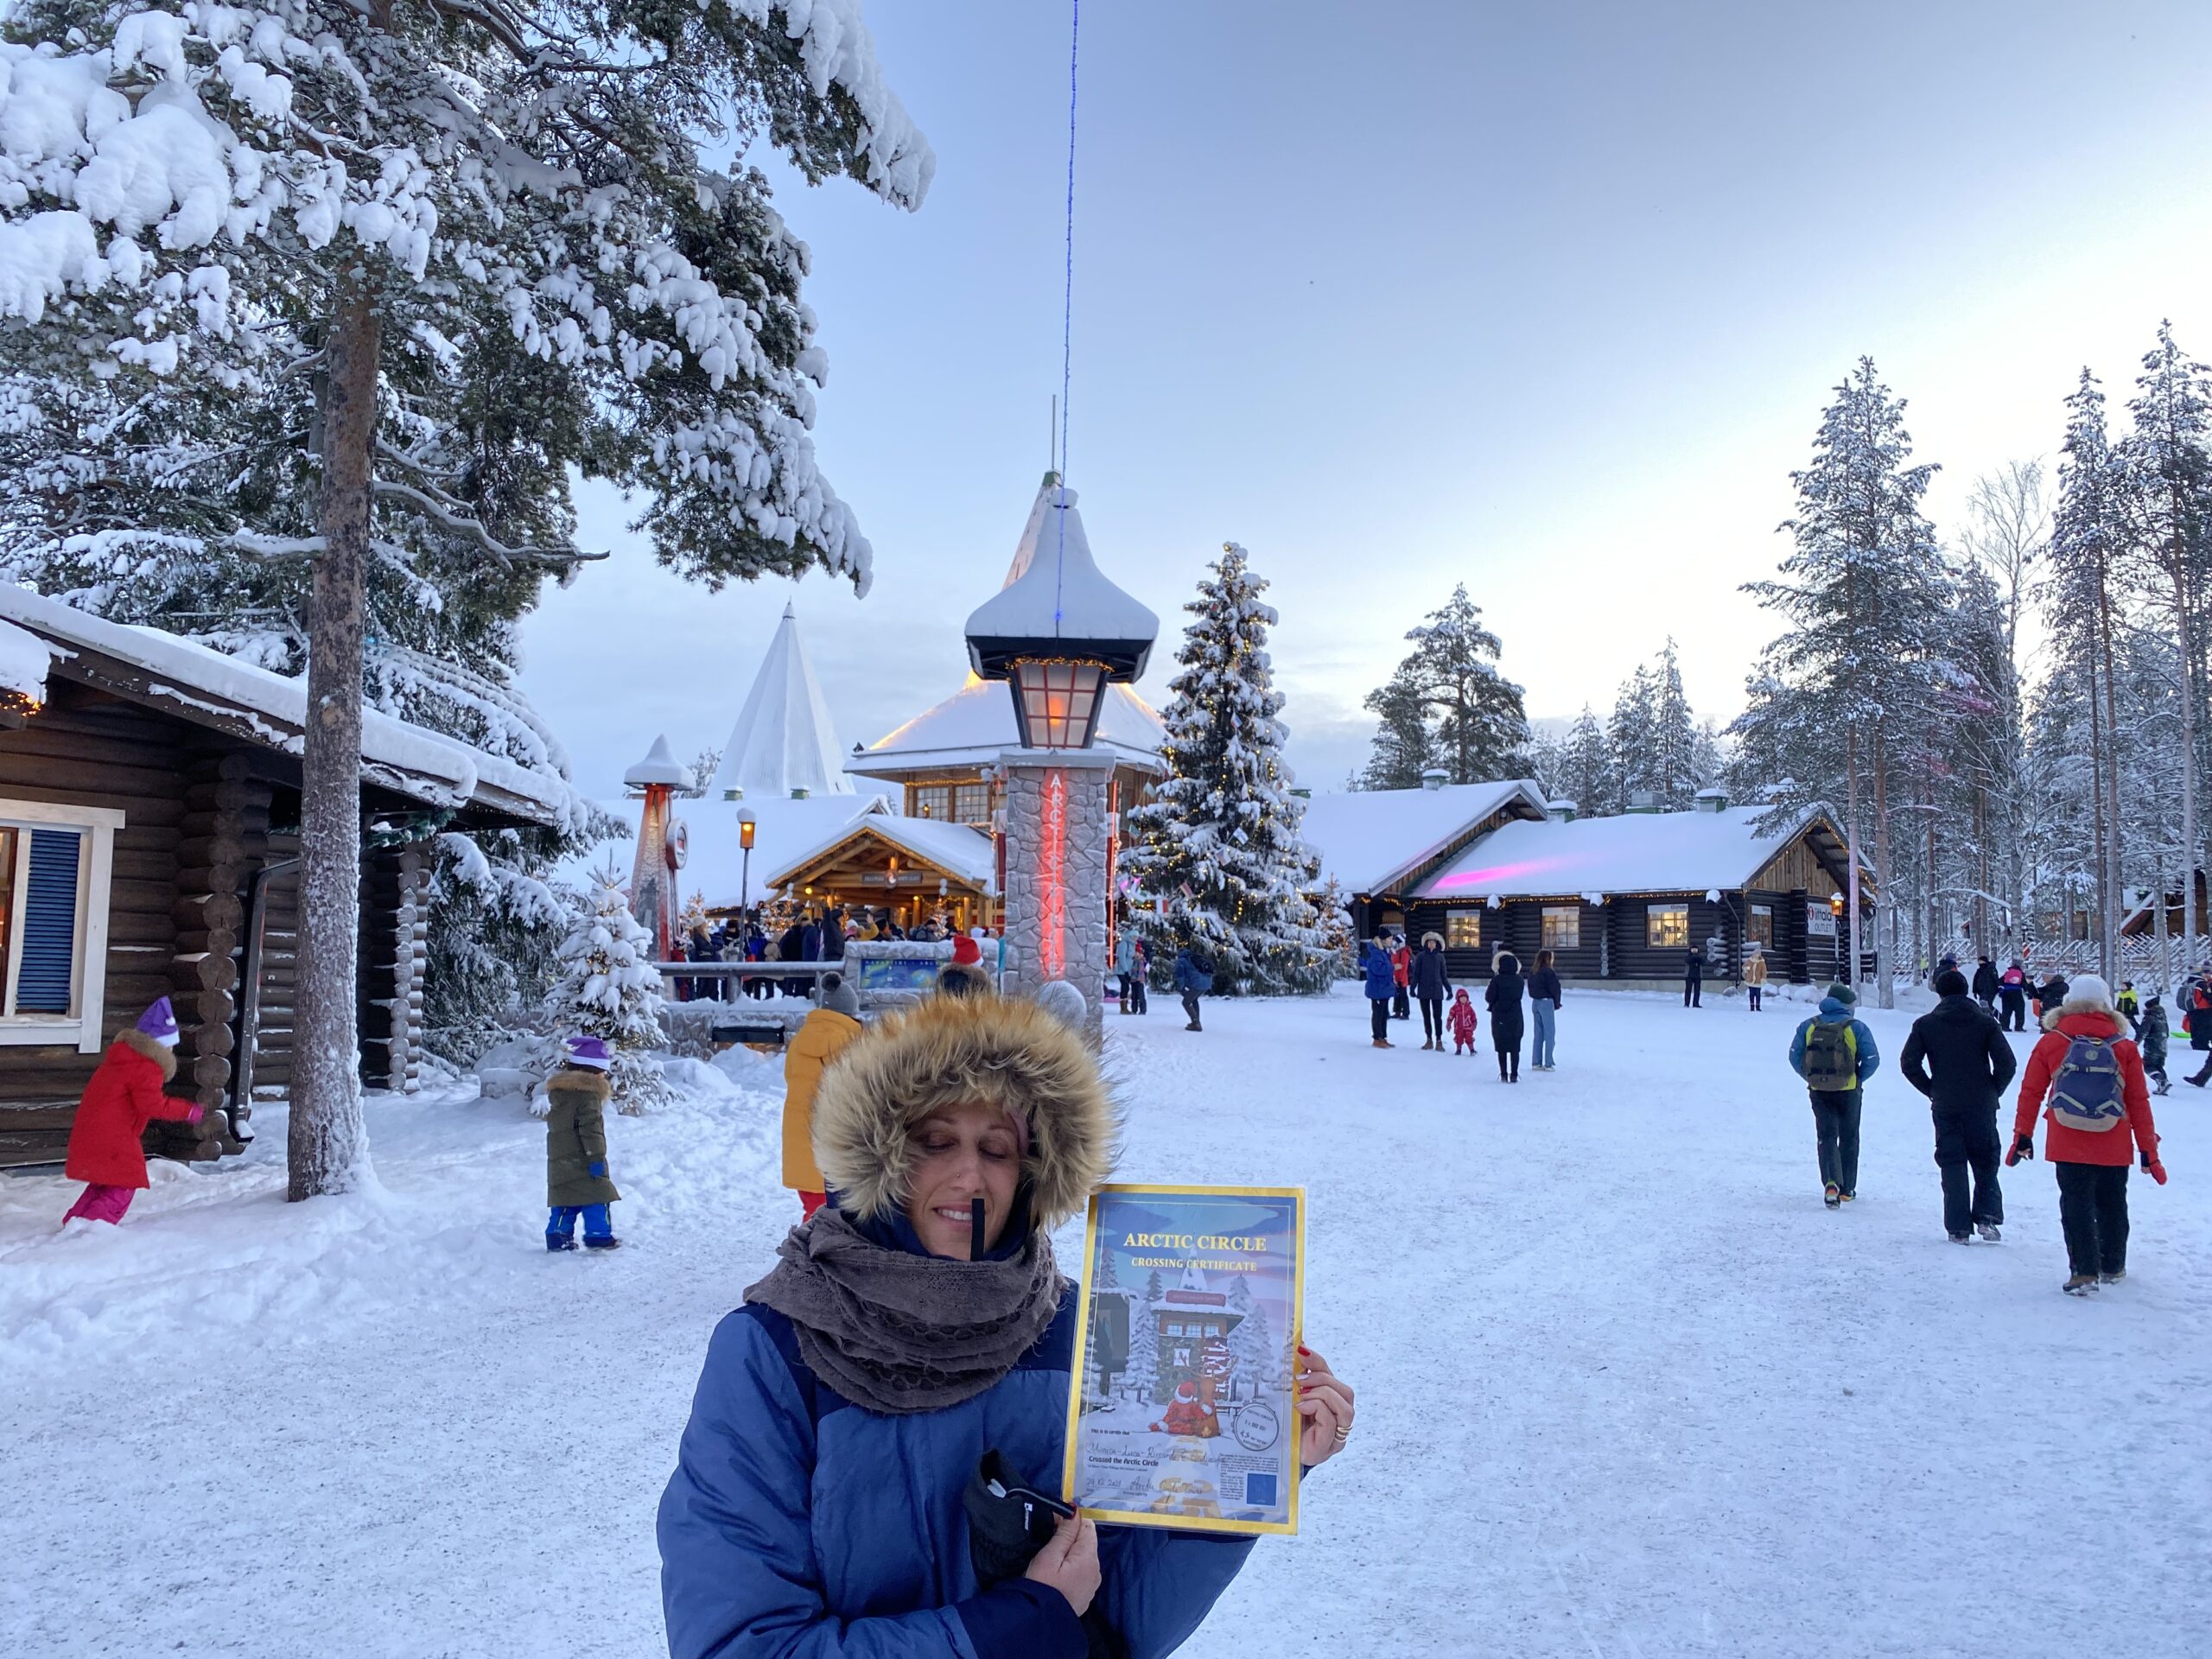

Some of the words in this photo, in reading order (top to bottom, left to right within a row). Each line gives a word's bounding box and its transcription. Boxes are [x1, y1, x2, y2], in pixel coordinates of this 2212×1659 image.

[1122, 1232, 1194, 1249] ARCTIC
[1197, 1235, 1267, 1252] CIRCLE
[1131, 1256, 1184, 1268] CROSSING
[1186, 1258, 1257, 1272] CERTIFICATE
[1089, 1455, 1112, 1464] Crossed
